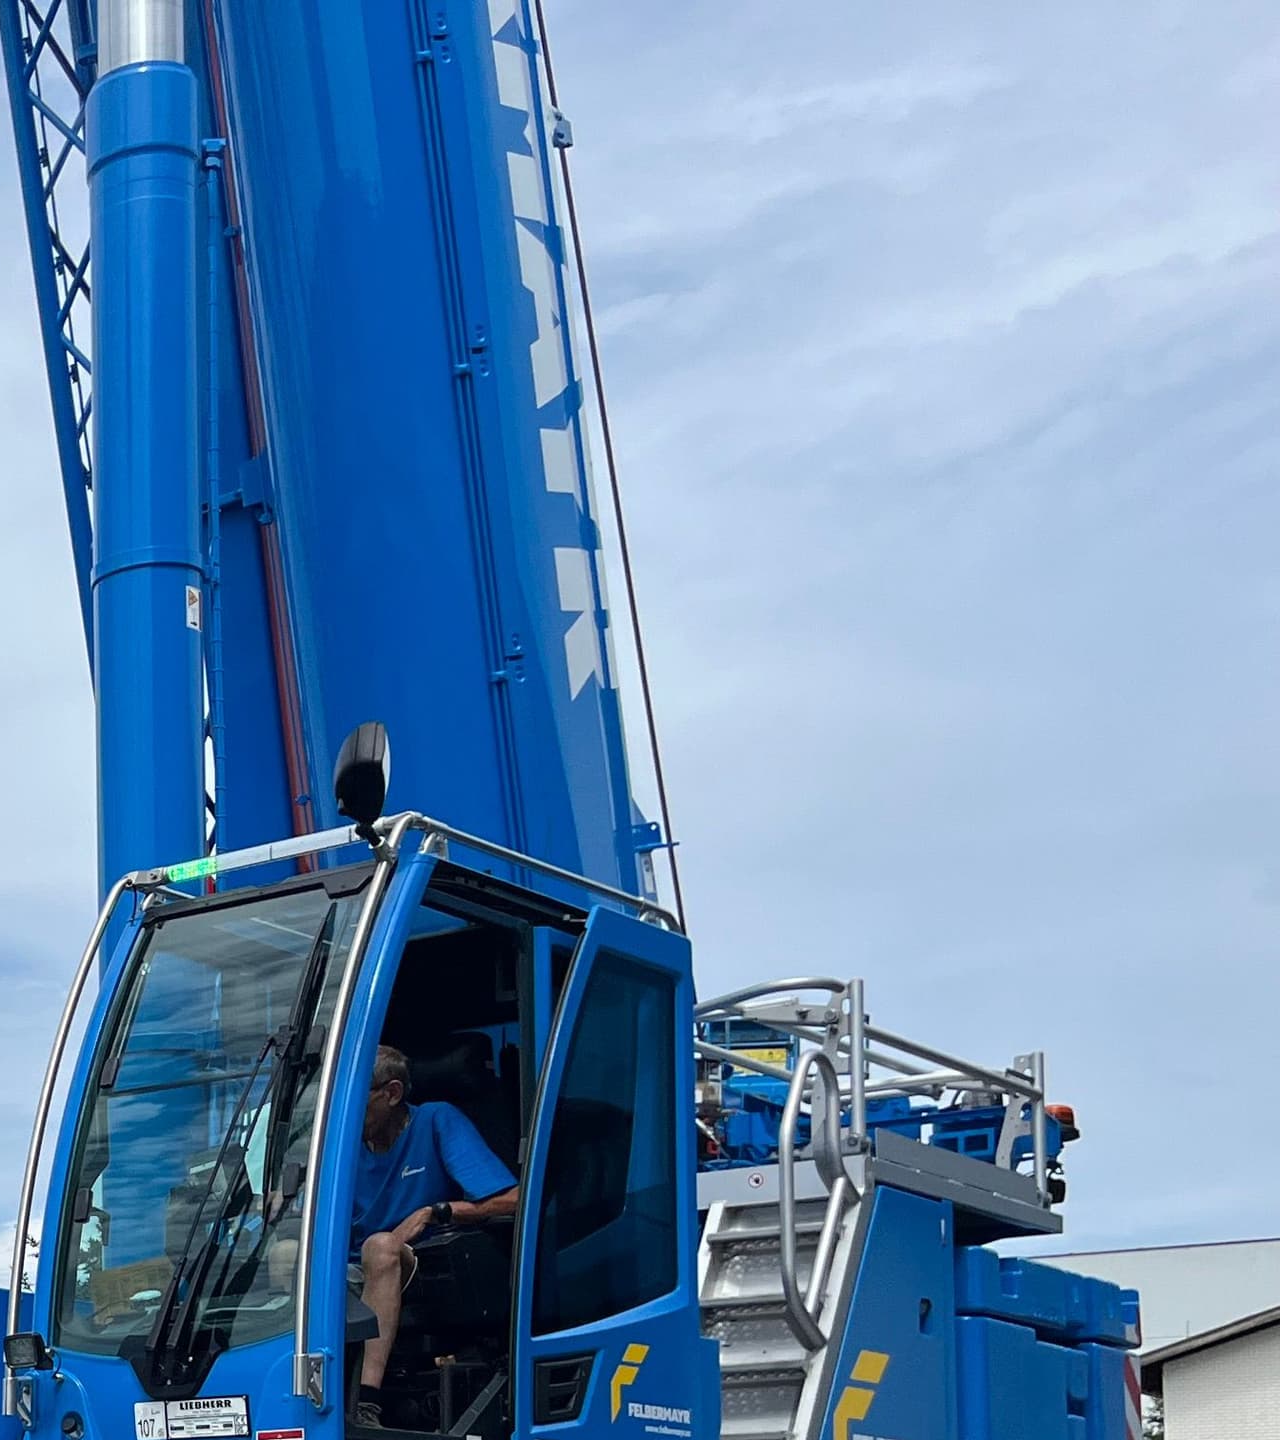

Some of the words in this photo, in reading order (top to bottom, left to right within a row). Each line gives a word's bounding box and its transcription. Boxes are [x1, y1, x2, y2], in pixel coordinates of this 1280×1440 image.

[180, 1399, 232, 1410] LIEBHERR
[628, 1402, 691, 1424] FELBERMAYR
[138, 1419, 155, 1437] 107
